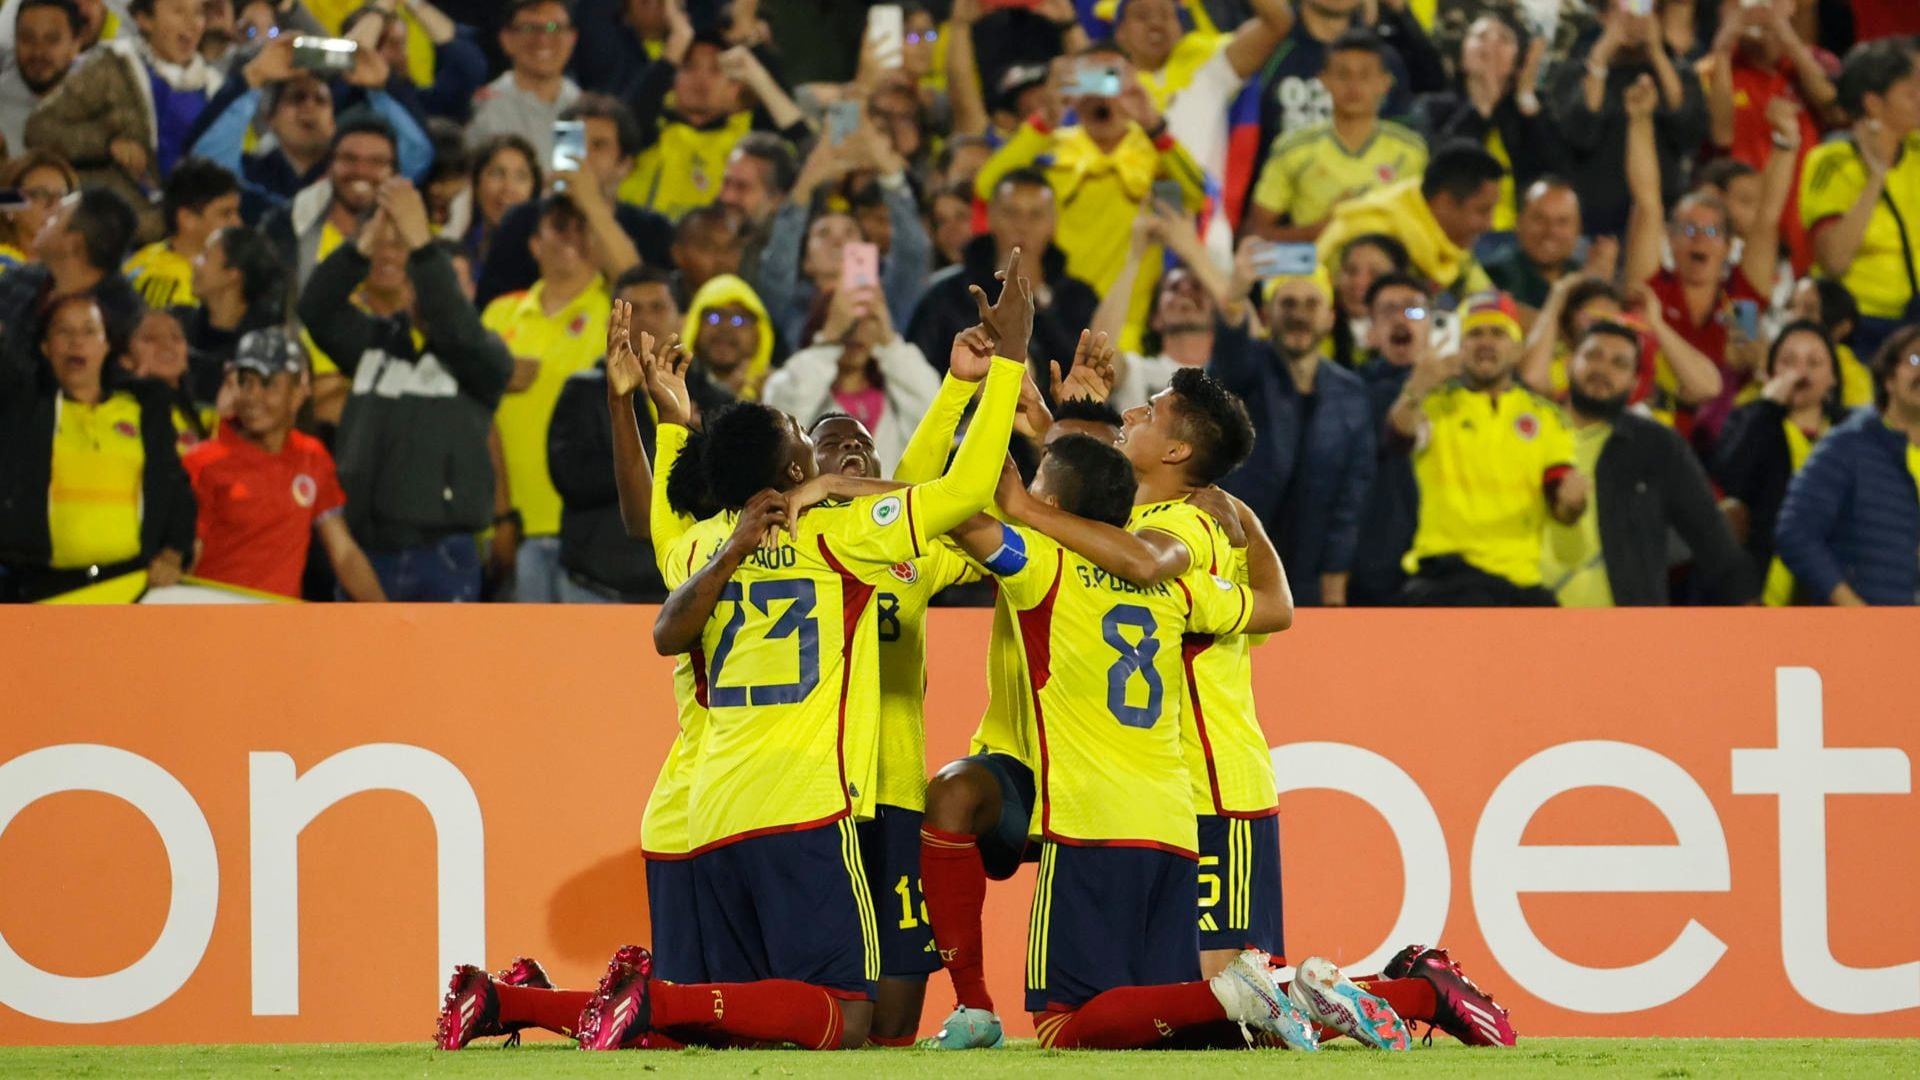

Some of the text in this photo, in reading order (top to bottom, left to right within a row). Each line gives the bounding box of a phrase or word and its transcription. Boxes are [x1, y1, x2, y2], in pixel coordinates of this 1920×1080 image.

[708, 578, 820, 707] 23
[1101, 603, 1164, 729] 8
[894, 874, 930, 930] 1
